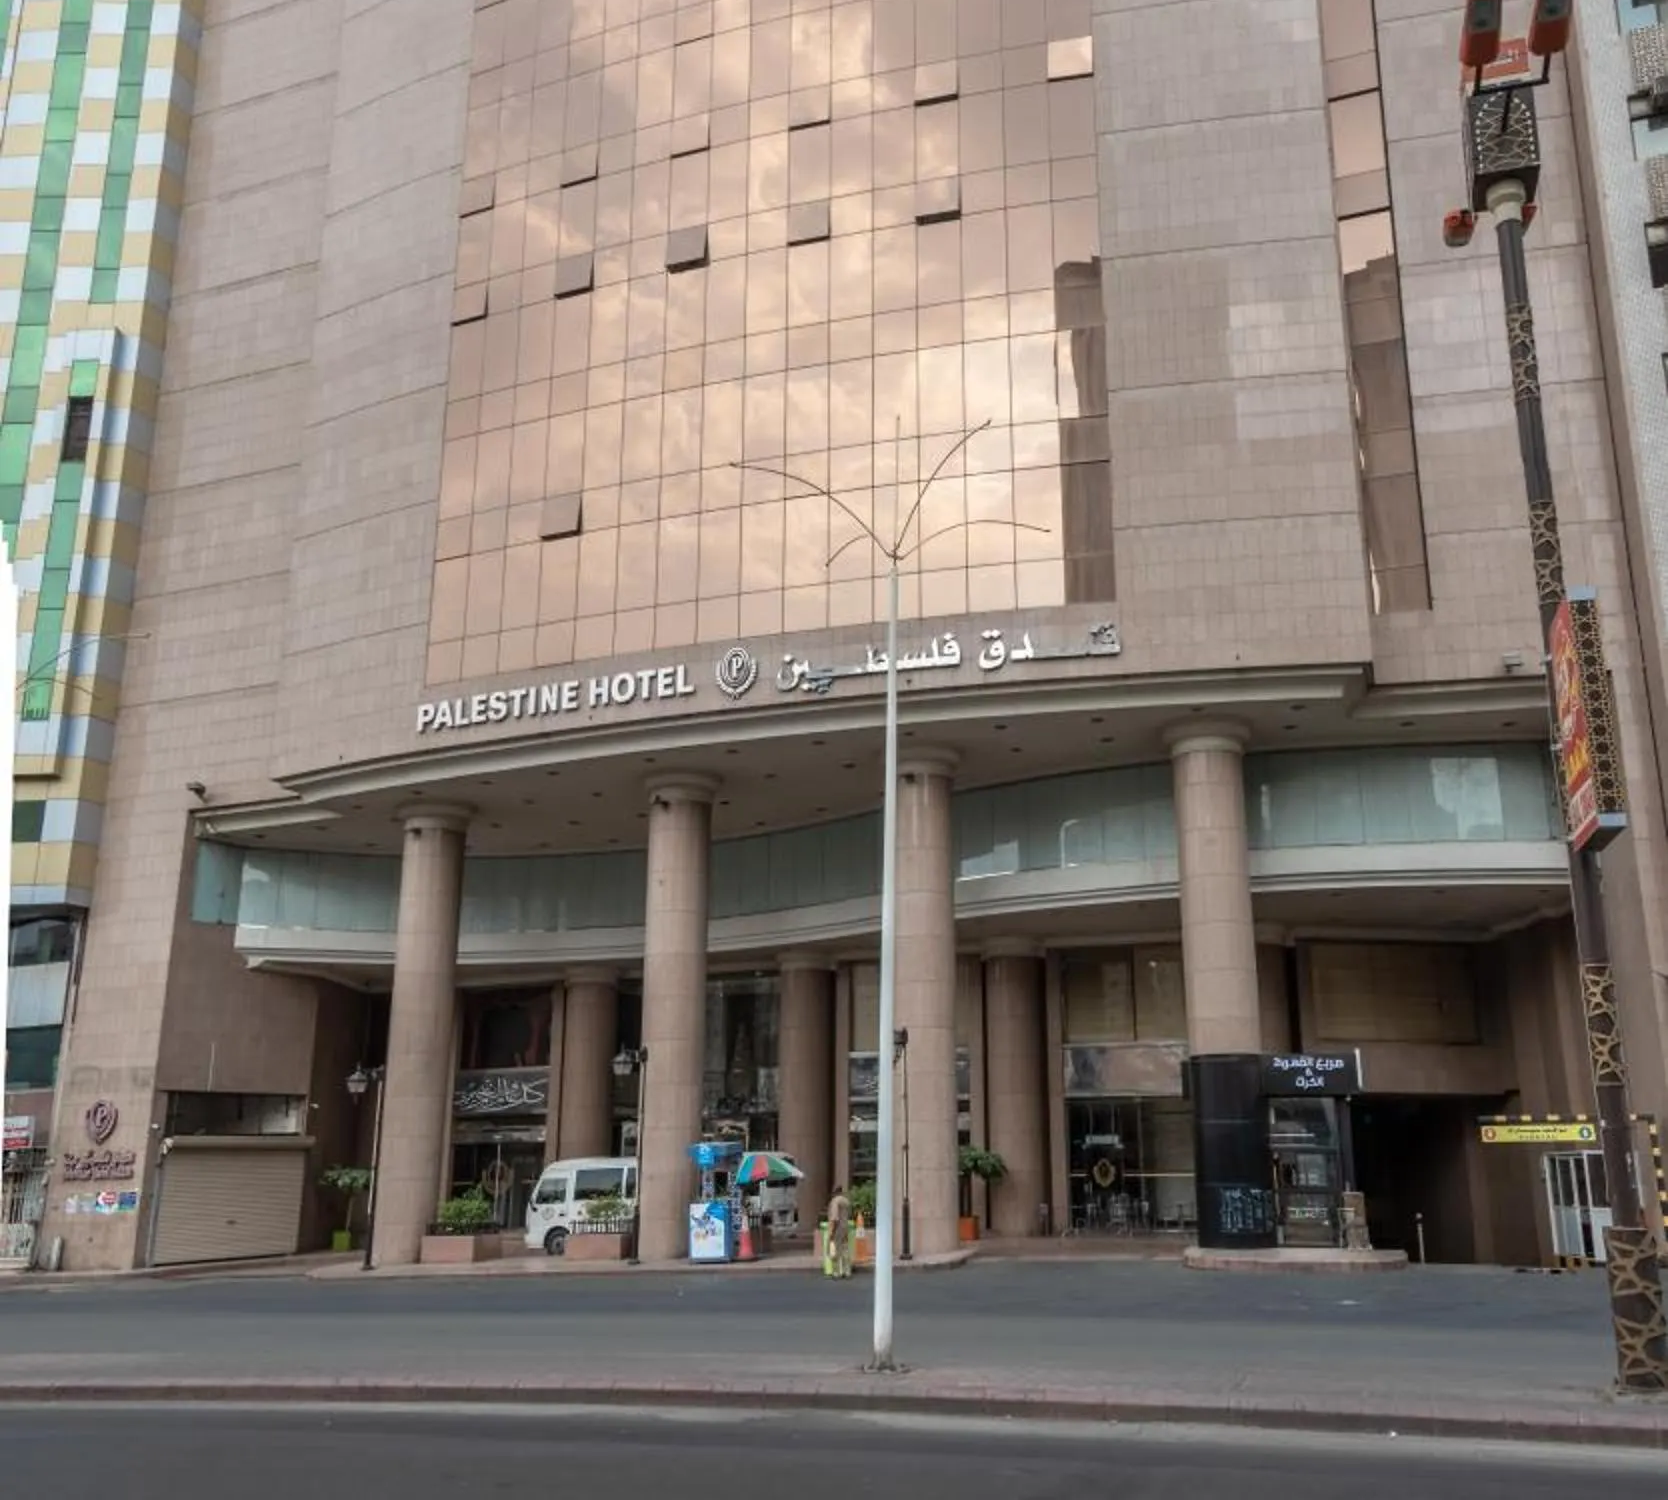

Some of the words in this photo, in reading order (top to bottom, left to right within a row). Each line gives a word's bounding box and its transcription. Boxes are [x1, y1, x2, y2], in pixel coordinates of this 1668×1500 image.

[776, 632, 961, 694] فلسطين
[979, 622, 1121, 670] فندق
[416, 680, 581, 733] PALESTINE
[589, 664, 696, 708] HOTEL
